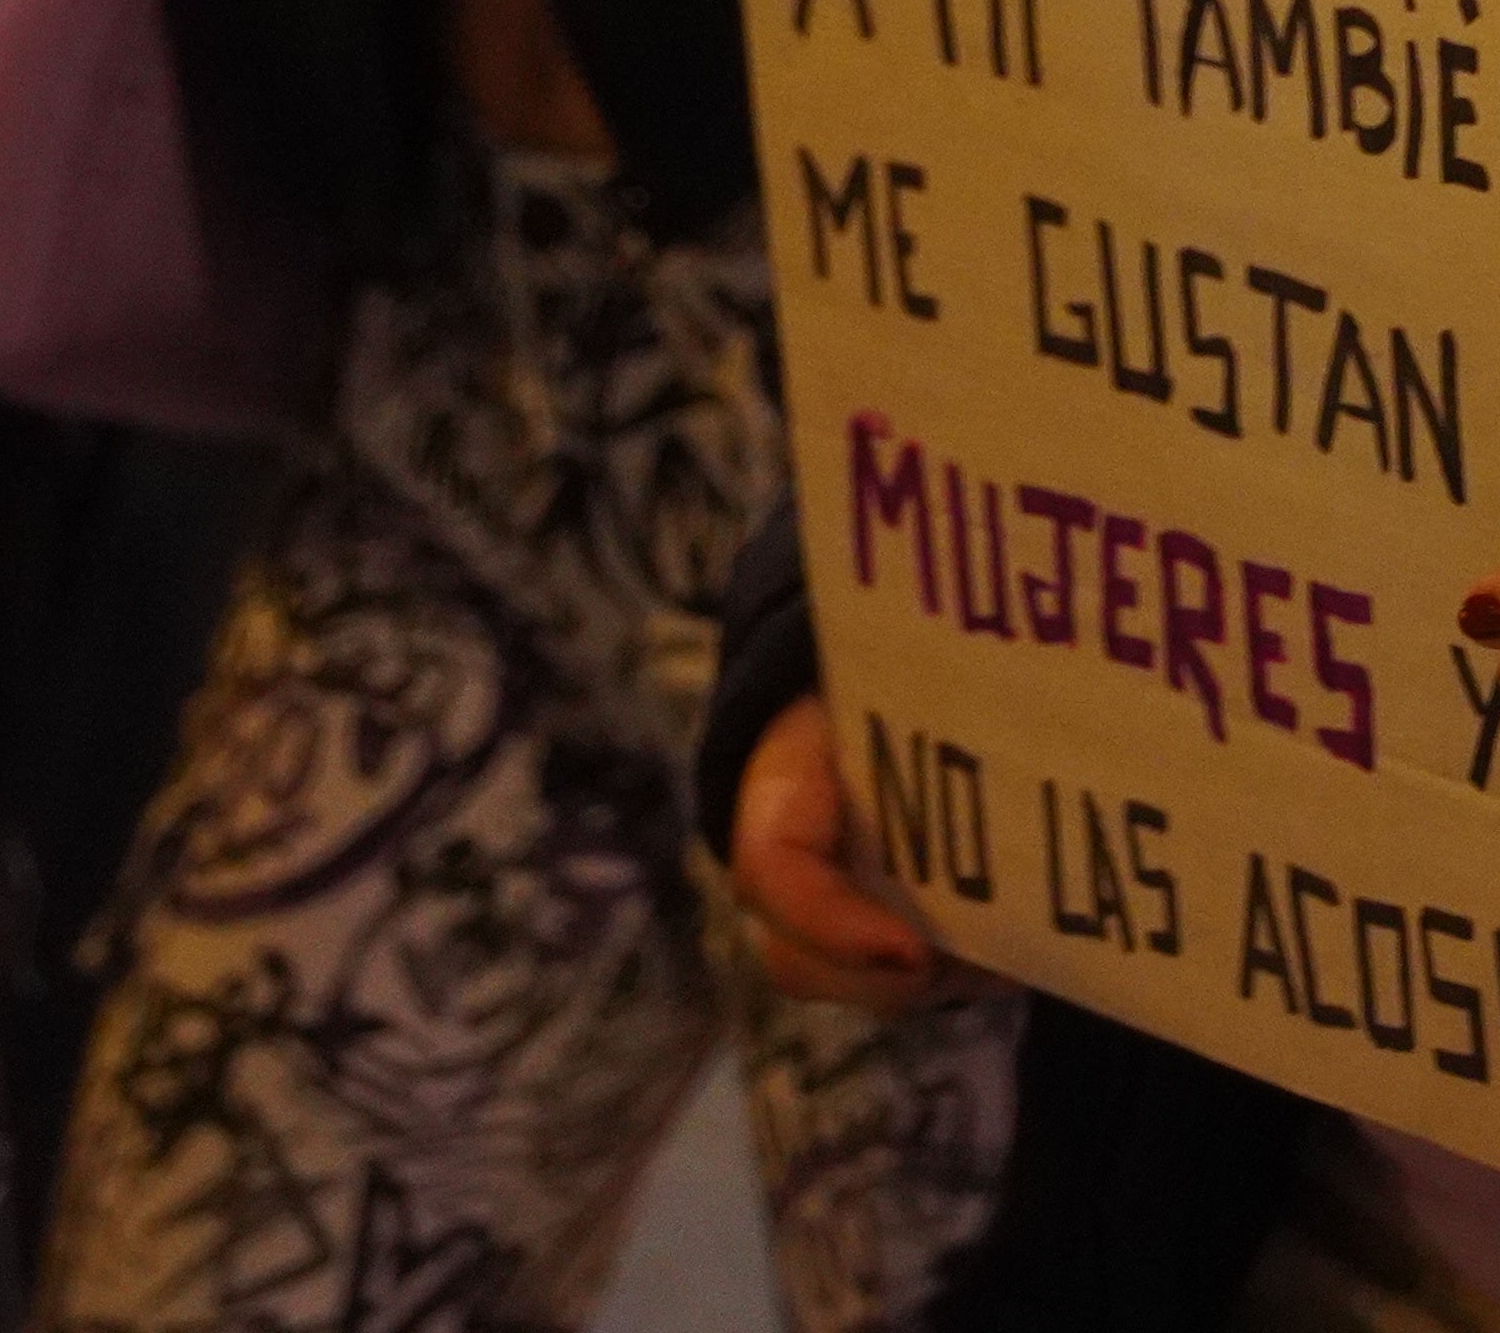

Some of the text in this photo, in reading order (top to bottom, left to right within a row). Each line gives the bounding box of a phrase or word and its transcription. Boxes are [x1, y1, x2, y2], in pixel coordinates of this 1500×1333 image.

[796, 145, 940, 321] ME
[1024, 193, 1468, 505] GUSTAN
[848, 409, 1376, 773] MUJERES
[866, 711, 994, 905] NO
[1040, 777, 1182, 957] LAS
